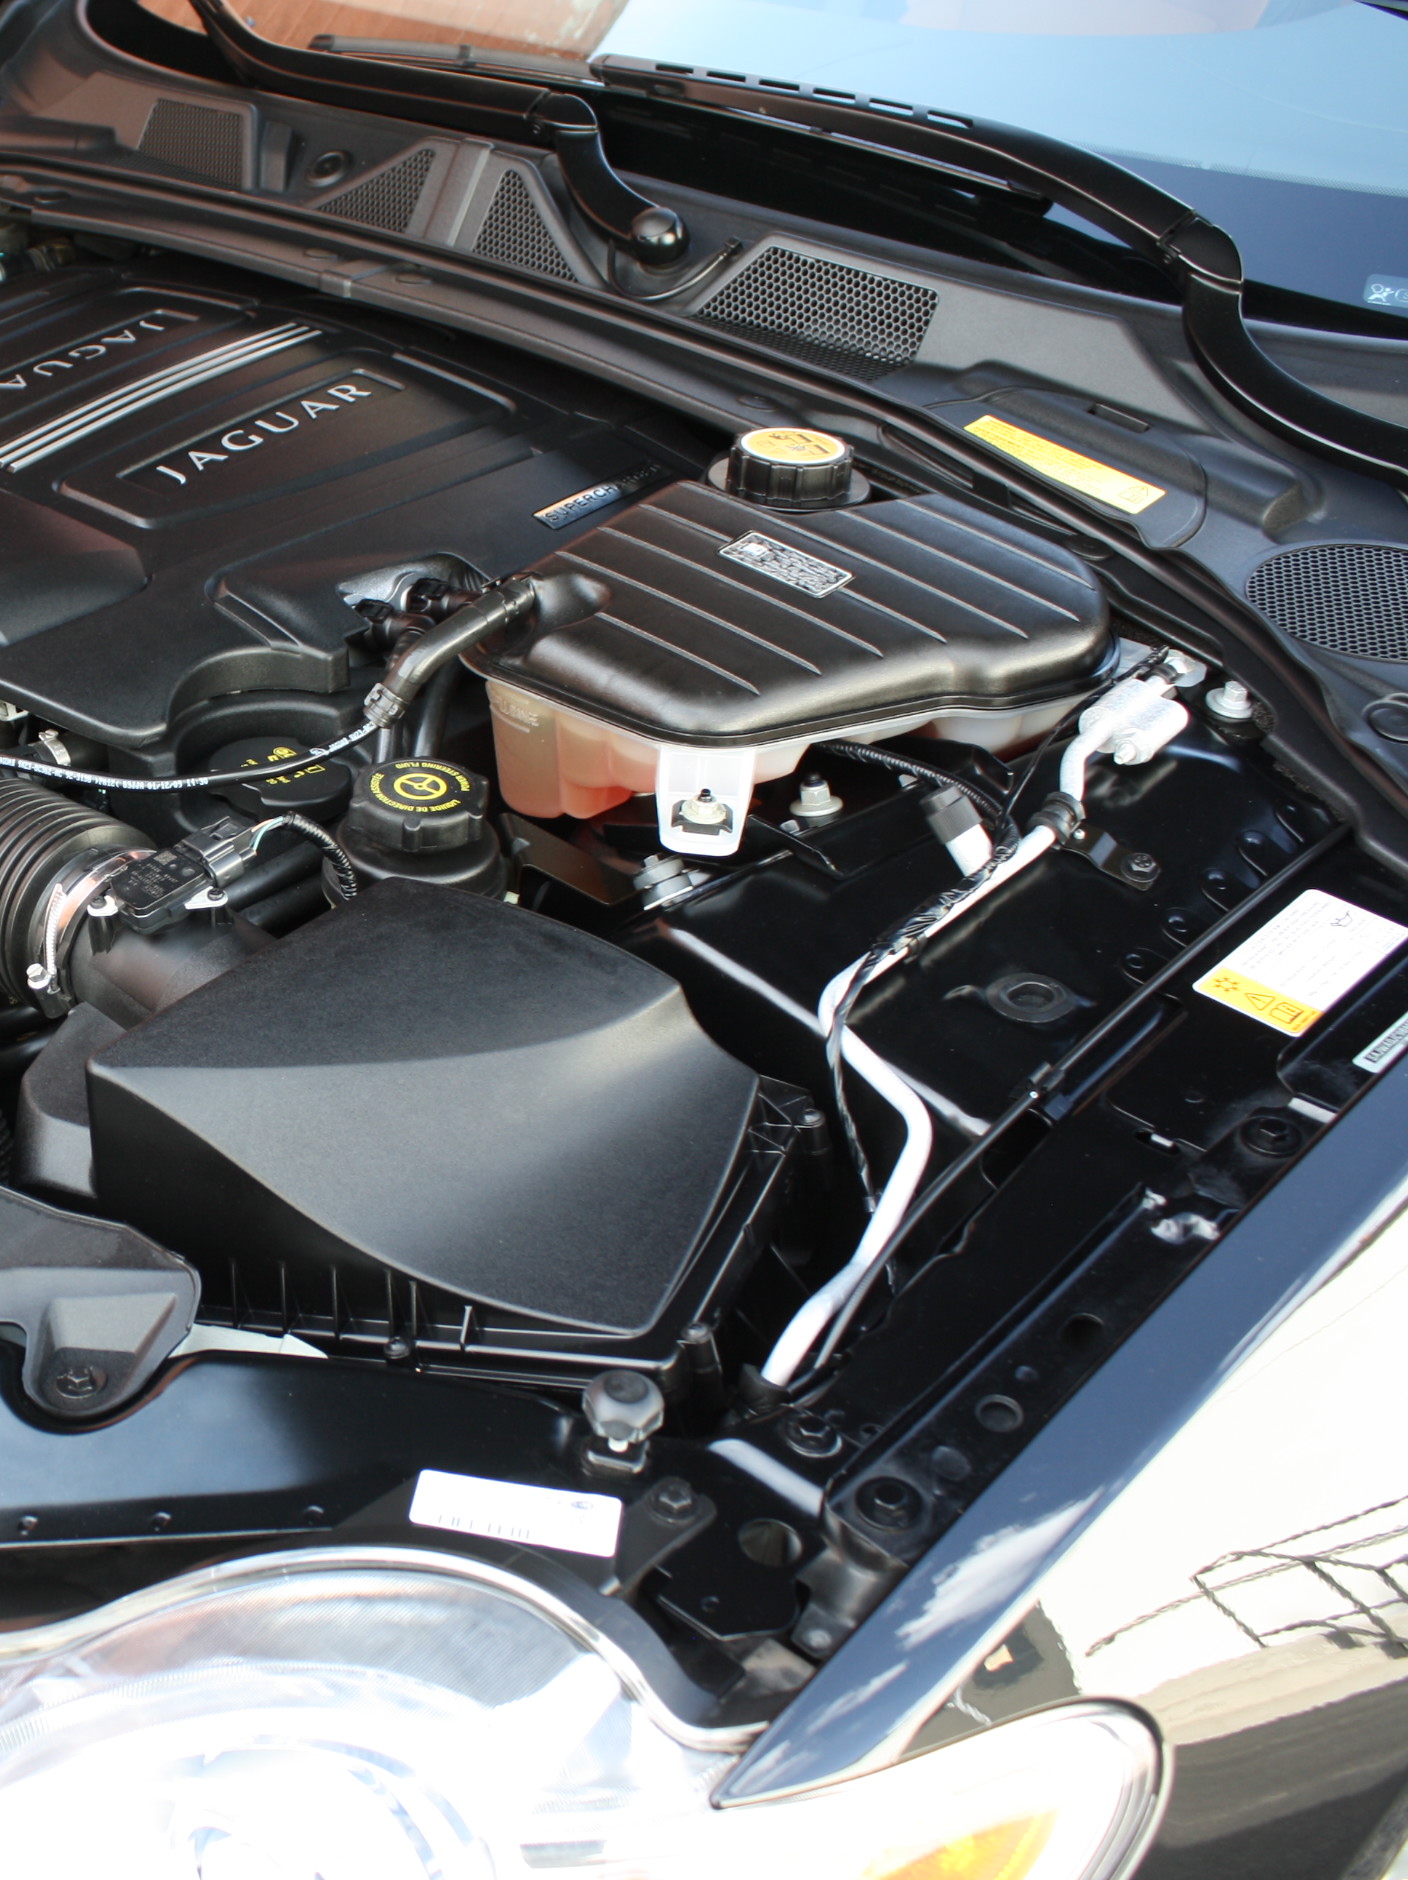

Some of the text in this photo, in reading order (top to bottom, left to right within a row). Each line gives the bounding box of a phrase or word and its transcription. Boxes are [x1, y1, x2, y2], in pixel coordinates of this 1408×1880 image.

[156, 384, 373, 486] JAGUAR
[395, 762, 420, 770] FLUID
[421, 762, 460, 777] STEERING
